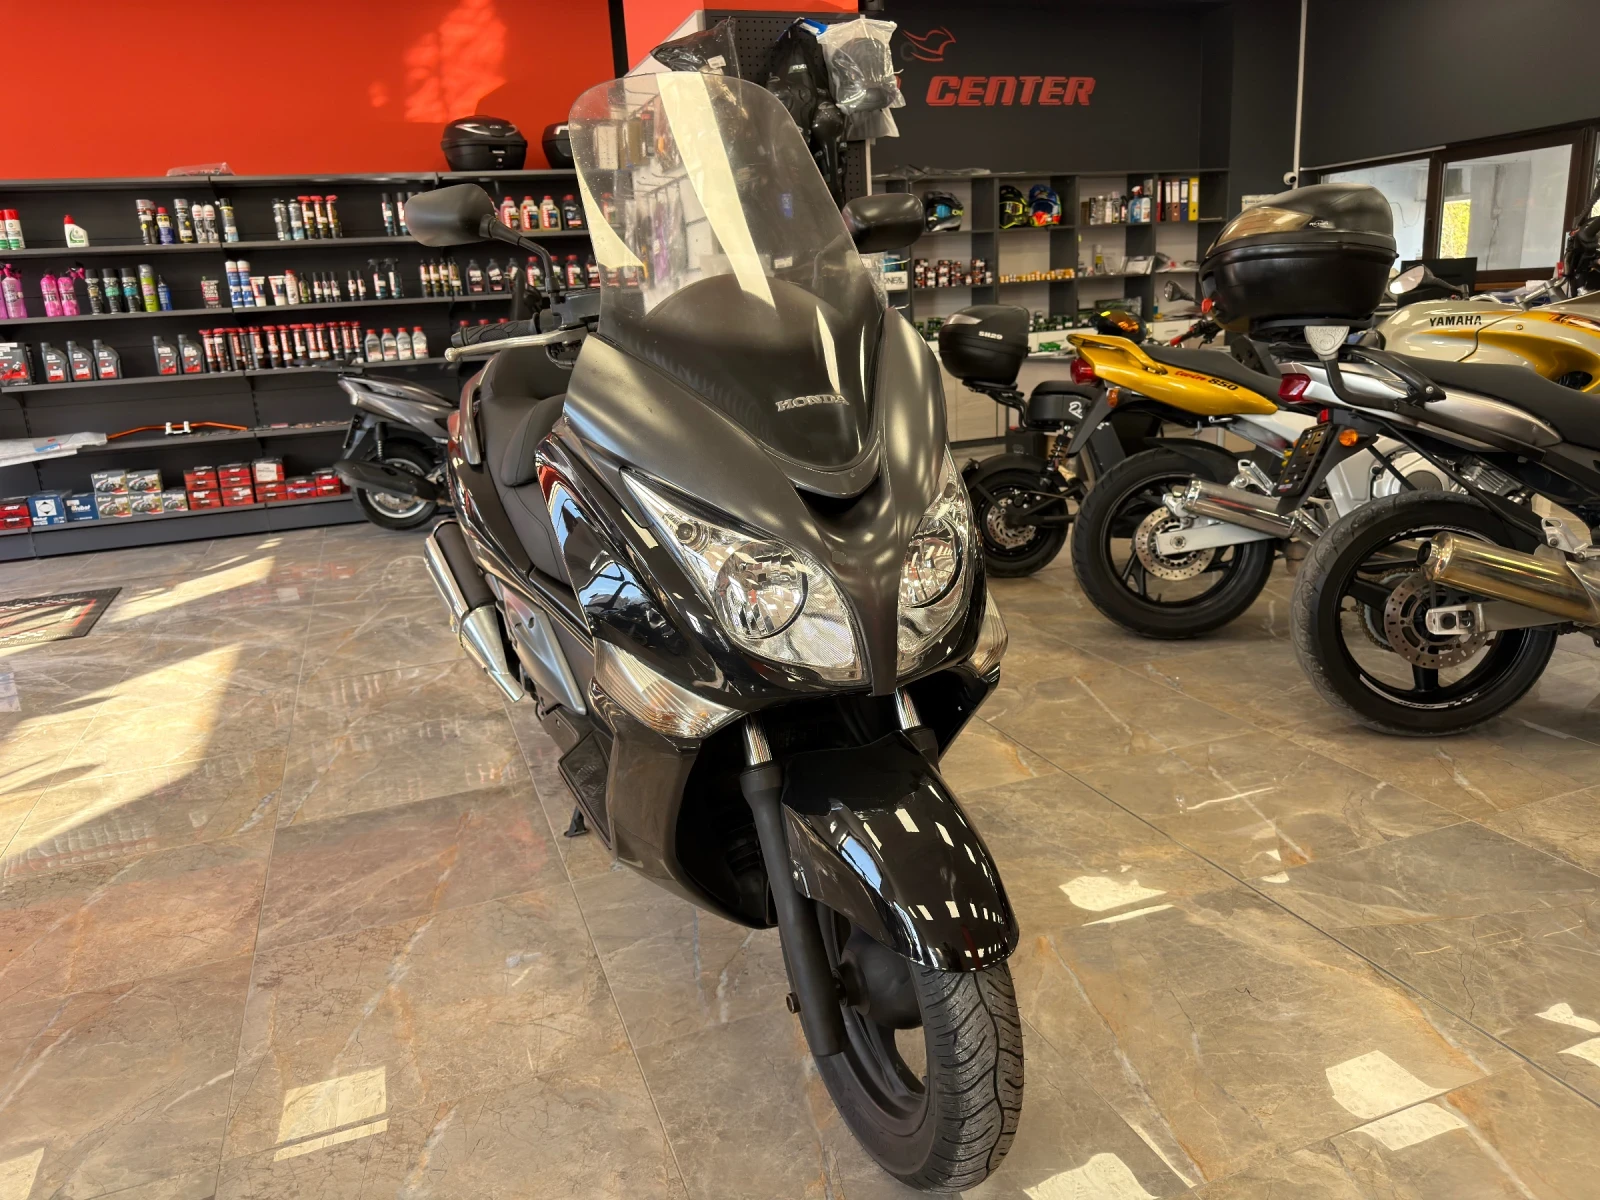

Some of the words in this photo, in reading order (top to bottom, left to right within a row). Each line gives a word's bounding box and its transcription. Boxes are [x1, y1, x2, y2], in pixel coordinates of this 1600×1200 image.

[926, 76, 1096, 106] CENTER
[1429, 315, 1482, 327] YAMAHA
[978, 330, 1003, 340] SH29
[1208, 378, 1239, 391] 850
[775, 393, 850, 412] HONDA
